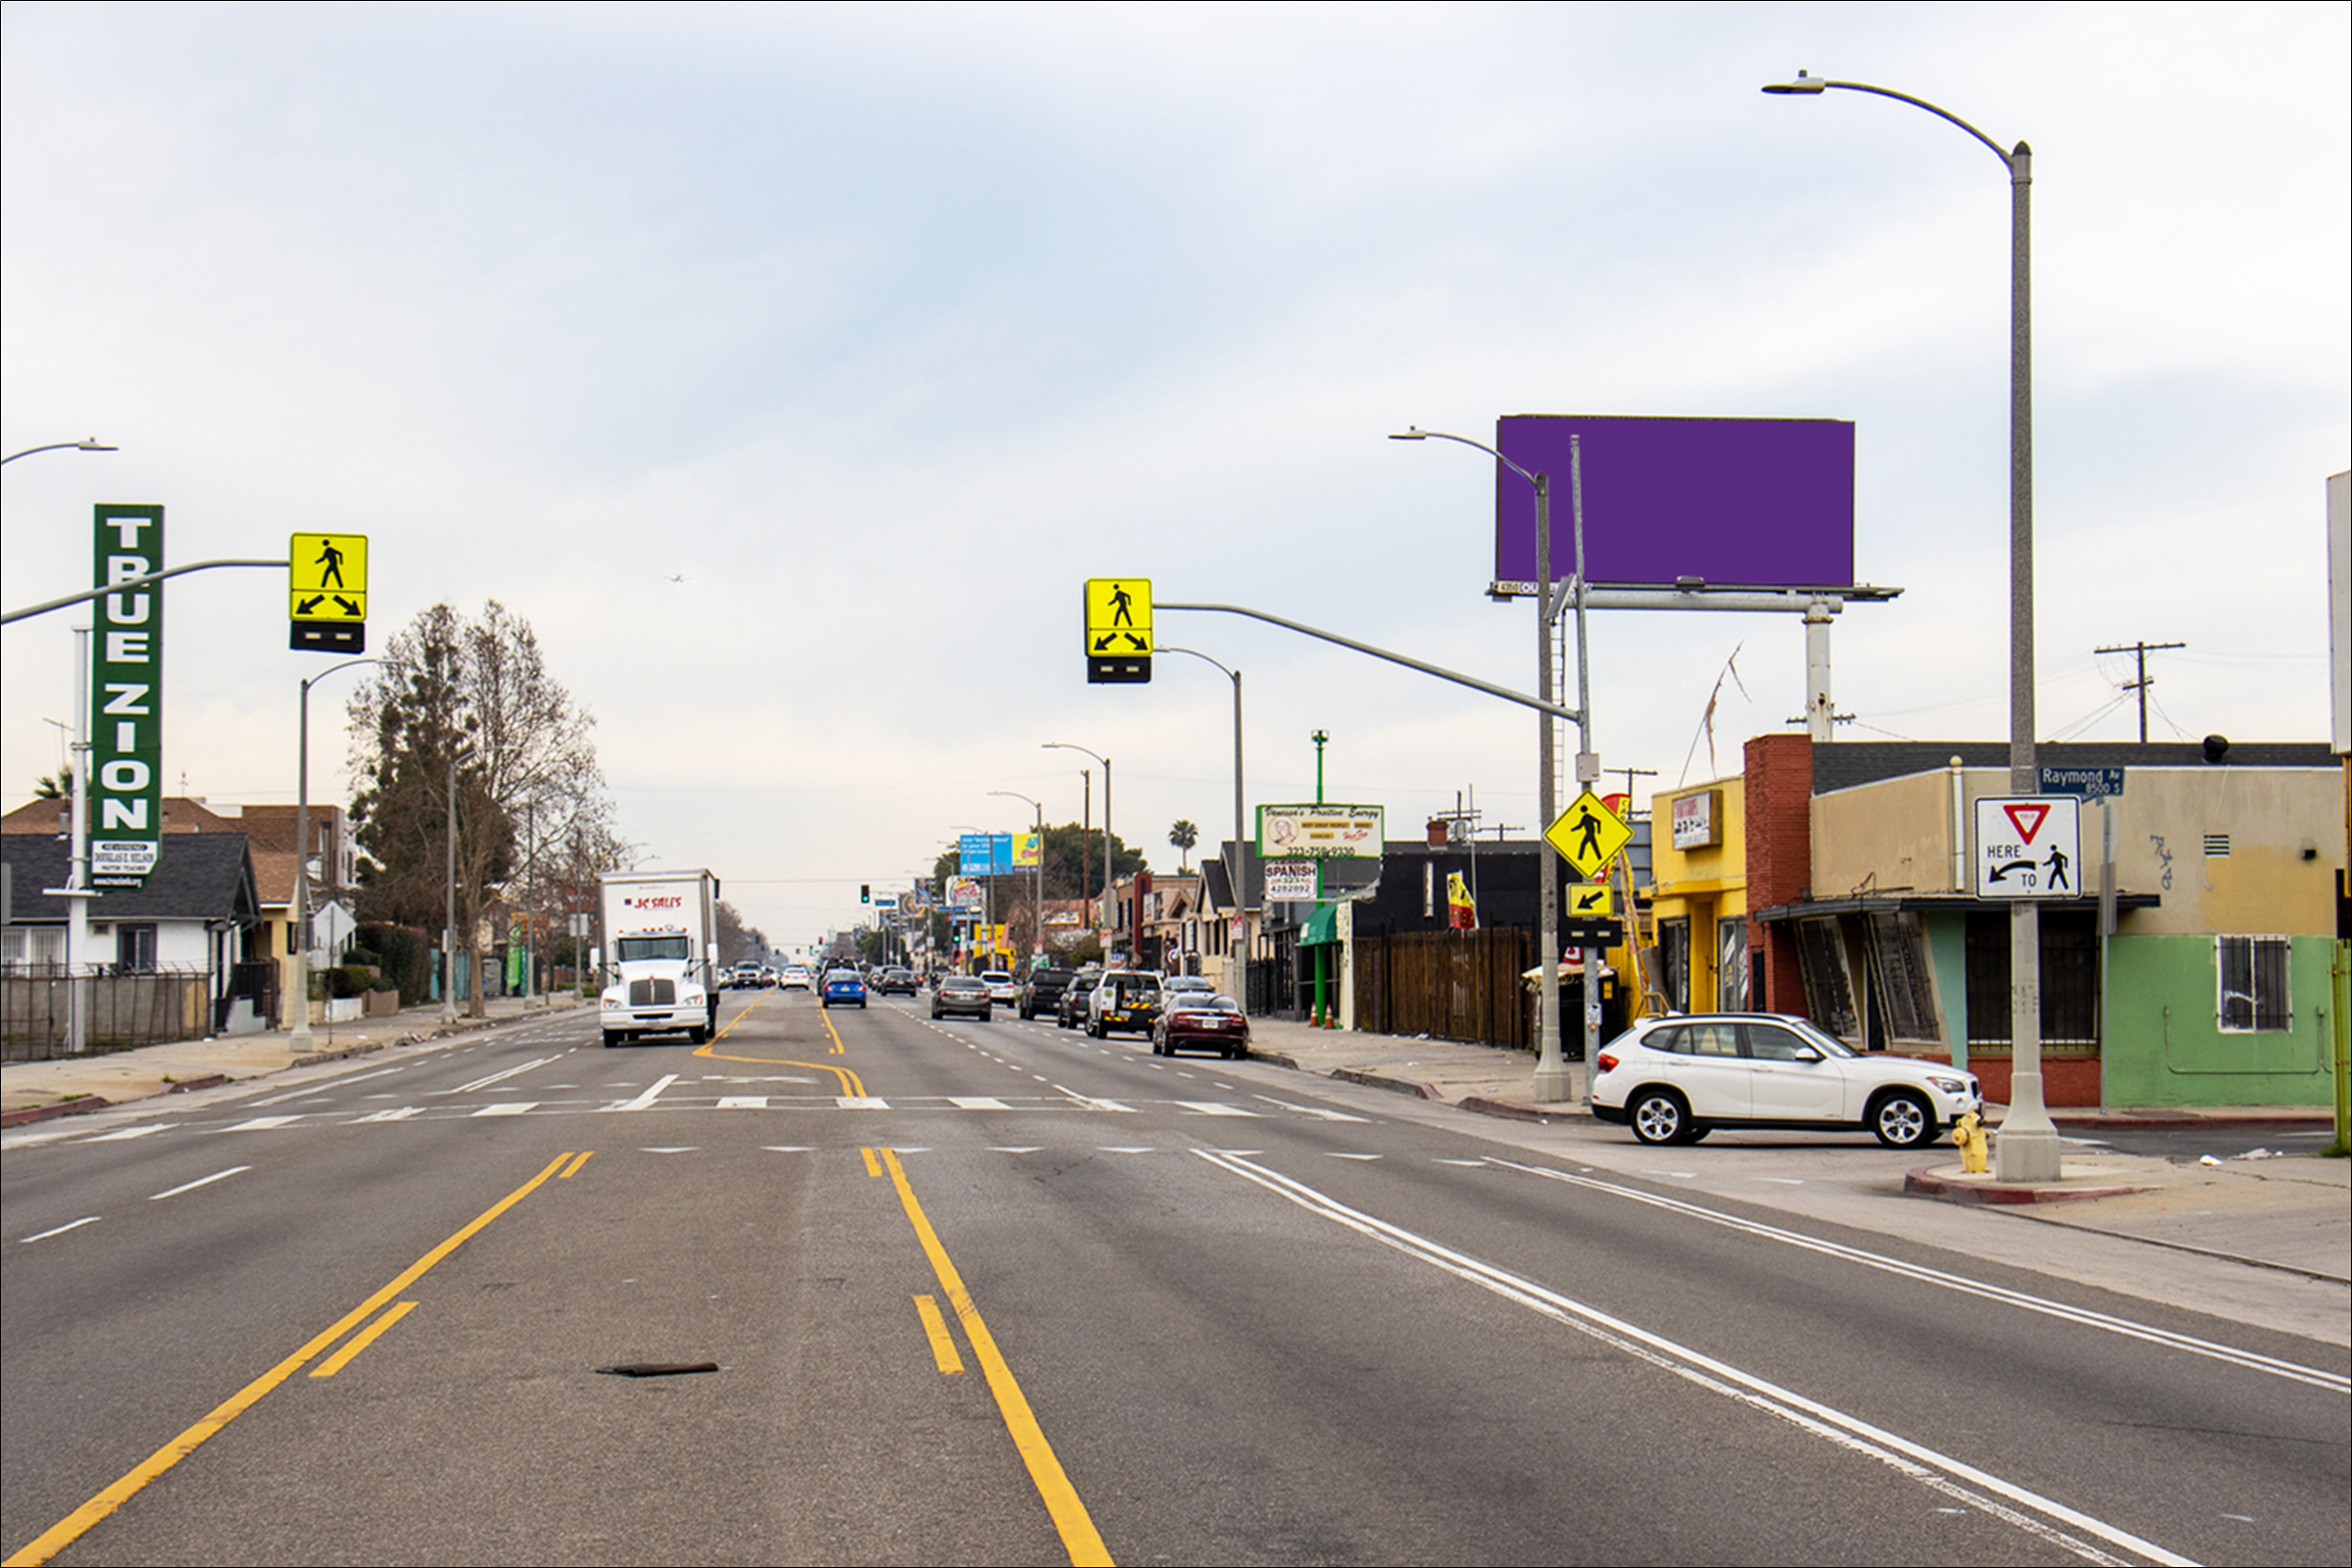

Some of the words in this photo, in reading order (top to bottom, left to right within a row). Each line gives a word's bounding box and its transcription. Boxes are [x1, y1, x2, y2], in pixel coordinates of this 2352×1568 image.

[106, 516, 152, 663] TRUE
[101, 683, 150, 829] ZION
[2042, 768, 2103, 786] Raymond
[2085, 783, 2111, 794] 8500
[2114, 783, 2121, 794] S
[1348, 807, 1380, 819] Energy
[1987, 845, 2021, 858] HERE
[1266, 864, 1316, 877] SPANISH
[2021, 873, 2036, 887] TO
[652, 896, 682, 908] SALES
